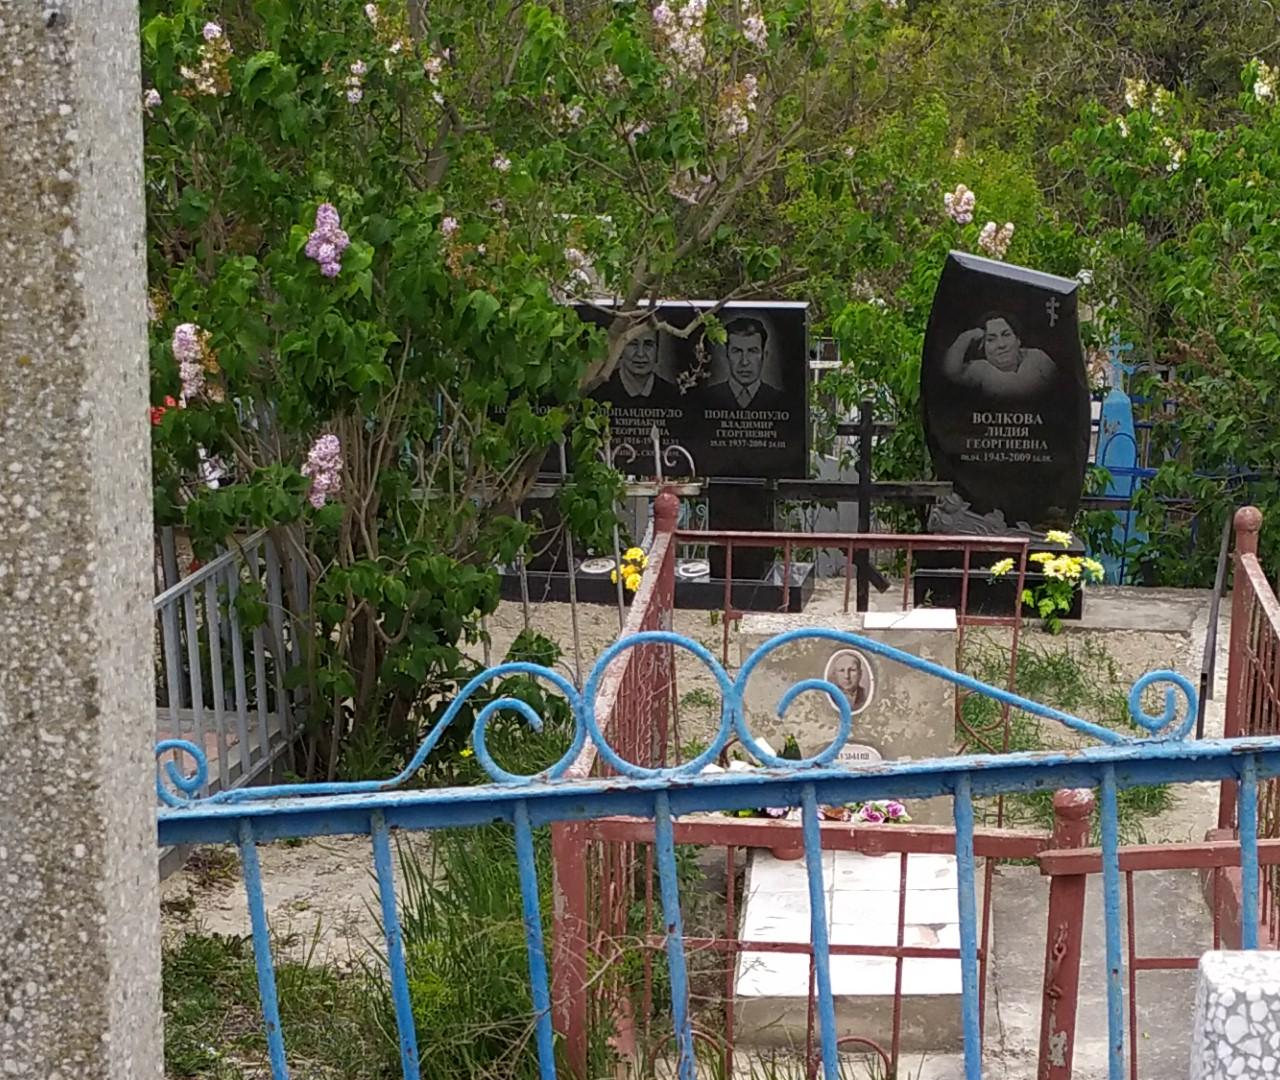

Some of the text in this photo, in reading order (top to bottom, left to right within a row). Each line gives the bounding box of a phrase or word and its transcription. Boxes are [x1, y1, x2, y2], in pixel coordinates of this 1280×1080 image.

[972, 412, 1044, 425] ВОЛКОВА
[984, 426, 1029, 437] ЛИДИЯ
[966, 438, 1048, 450] ГЕОРГИЕВНА
